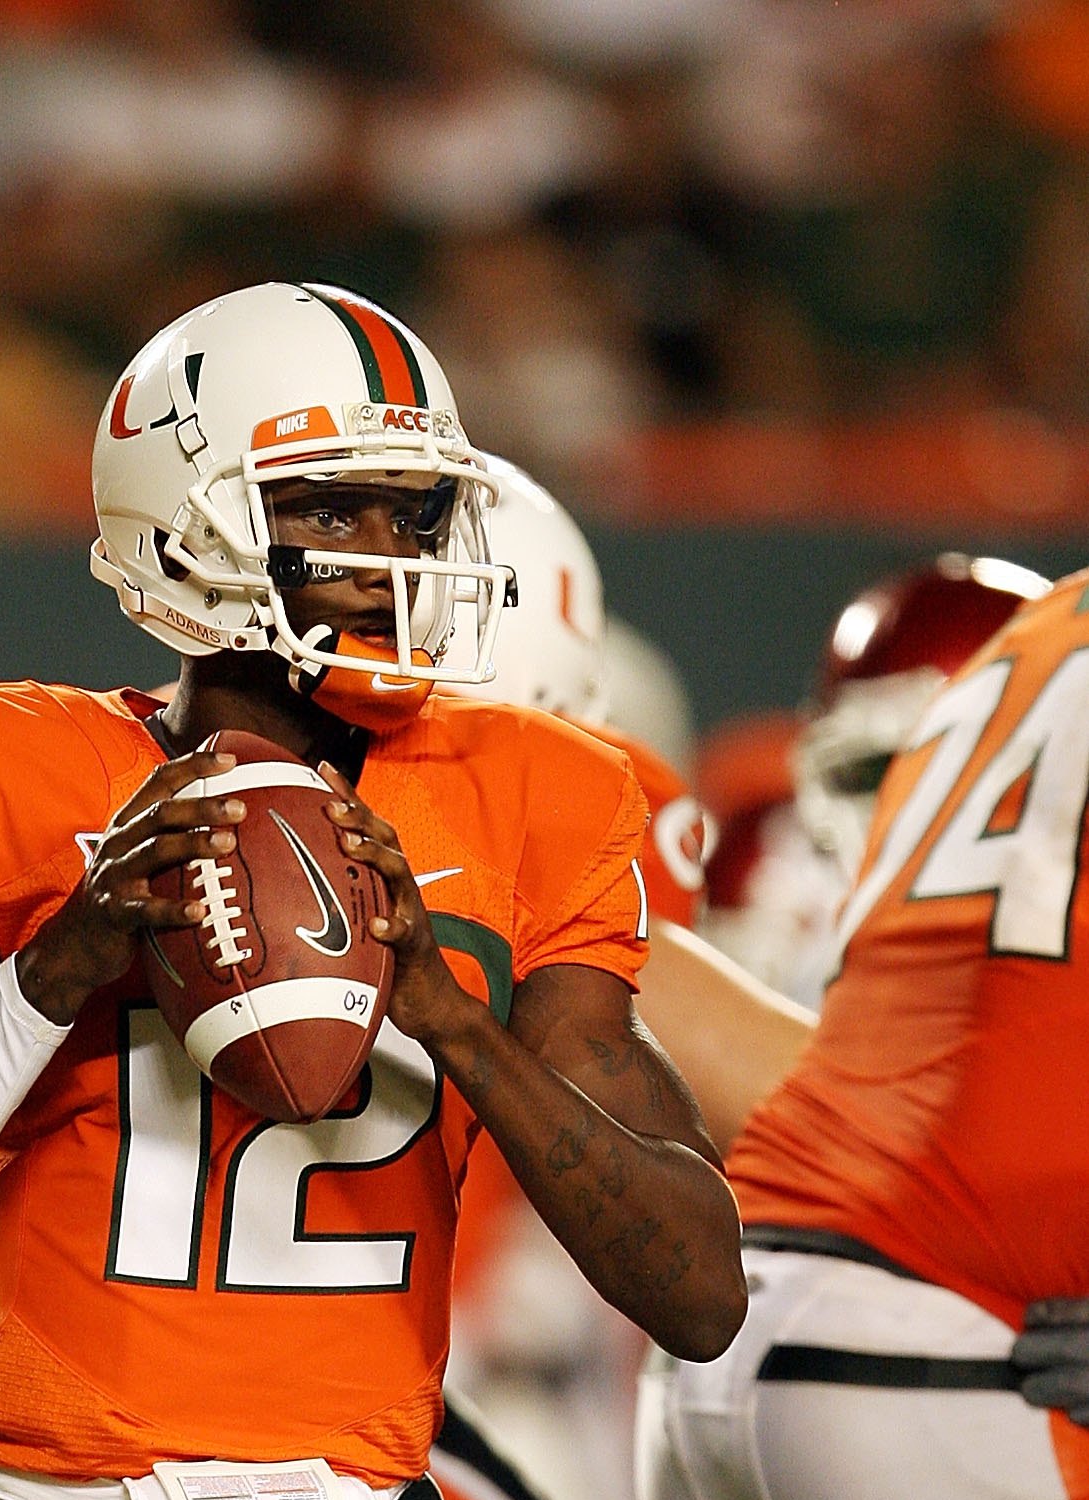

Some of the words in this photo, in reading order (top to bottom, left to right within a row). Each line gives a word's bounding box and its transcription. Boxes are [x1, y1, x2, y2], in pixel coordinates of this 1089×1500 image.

[276, 412, 309, 438] NIKE
[382, 408, 429, 432] ACC
[165, 608, 221, 643] ADAMS
[105, 1000, 442, 1292] 12
